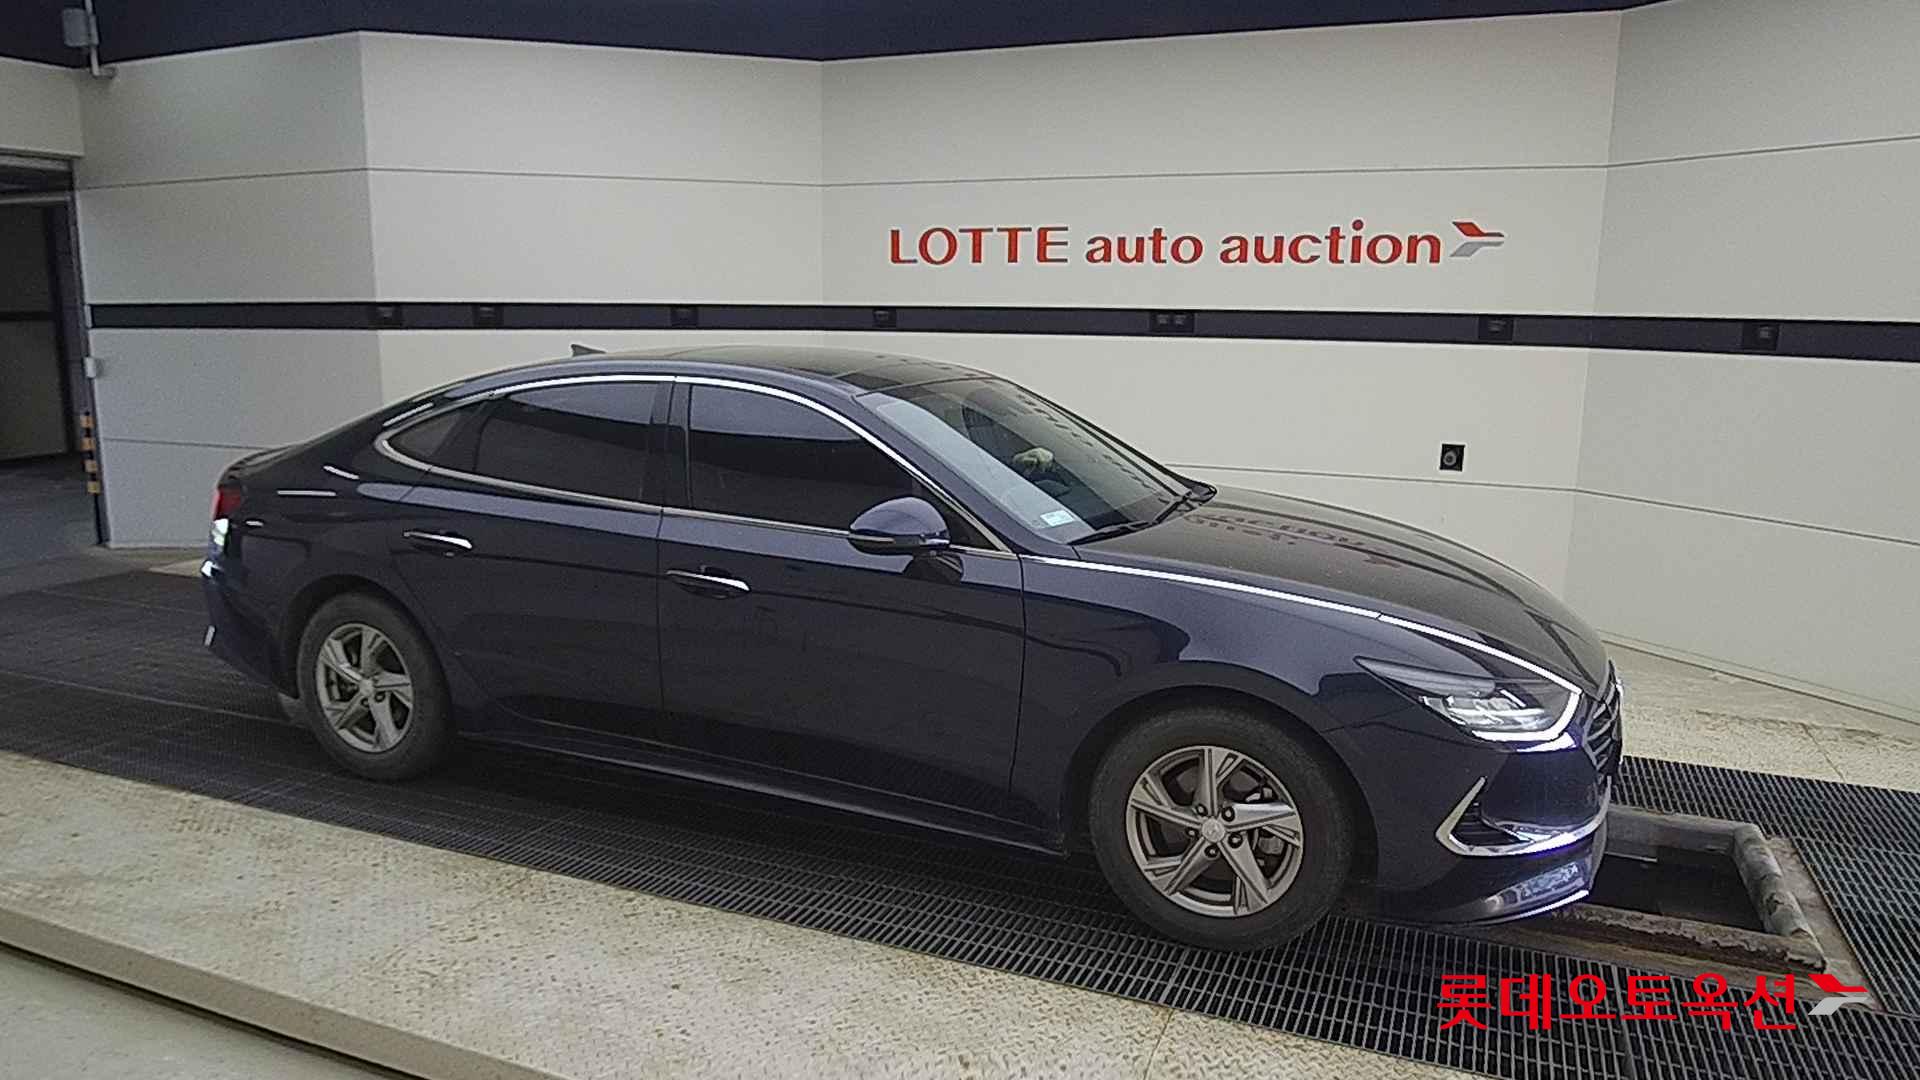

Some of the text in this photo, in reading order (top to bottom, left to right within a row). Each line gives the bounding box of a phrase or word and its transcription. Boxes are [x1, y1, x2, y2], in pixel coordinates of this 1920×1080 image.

[889, 219, 1442, 265] LOTTE auto auction
